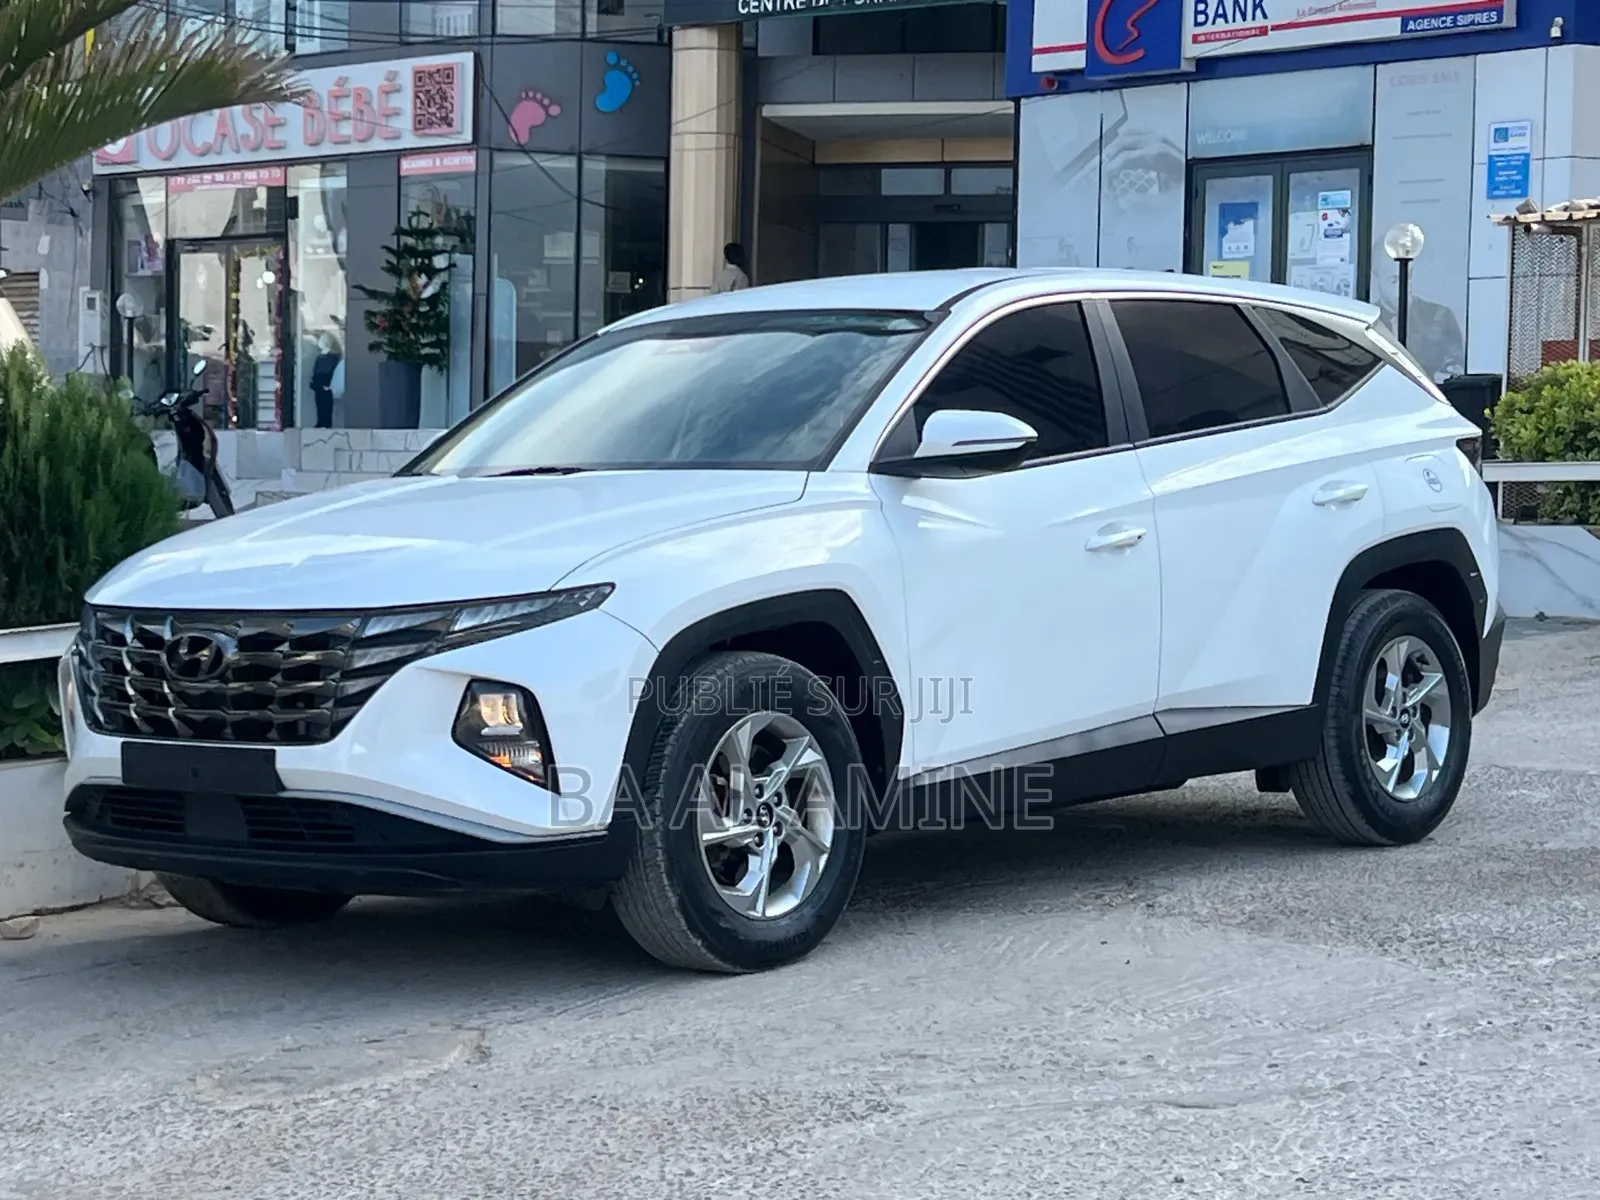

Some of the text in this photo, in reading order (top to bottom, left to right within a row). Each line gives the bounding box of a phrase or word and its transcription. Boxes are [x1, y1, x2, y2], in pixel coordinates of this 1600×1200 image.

[738, 0, 807, 14] CENTRE
[1194, 0, 1268, 27] BANK
[1407, 11, 1498, 31] AGENCE SIPRES
[303, 71, 404, 147] BÉBÉ
